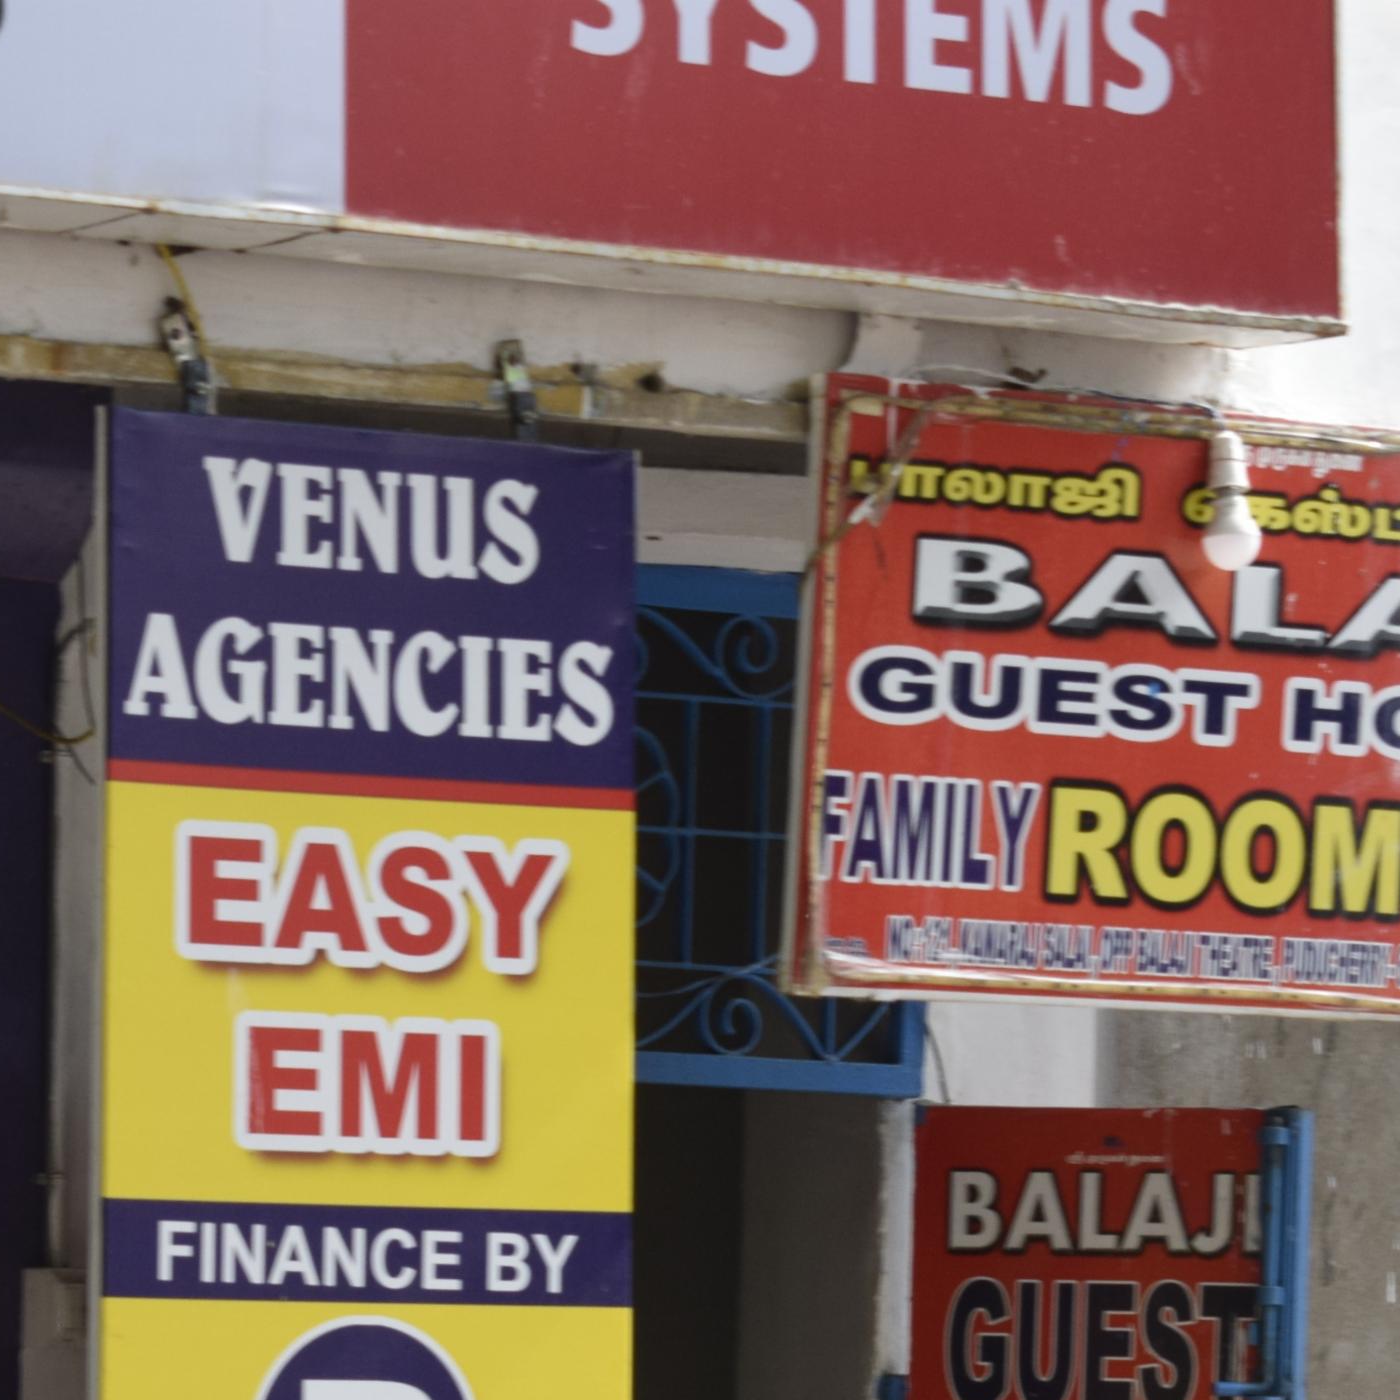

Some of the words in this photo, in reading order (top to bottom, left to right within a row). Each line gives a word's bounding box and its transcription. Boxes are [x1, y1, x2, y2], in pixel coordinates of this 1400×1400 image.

[203, 455, 540, 586] VENUS
[122, 613, 616, 747] AGENCIES
[847, 644, 1261, 747] GUEST
[819, 769, 1039, 890] FAMILY
[174, 819, 570, 977] EASY
[233, 1010, 502, 1159] EMI
[156, 1220, 464, 1291] FINANCE
[485, 1233, 579, 1294] BY
[947, 1168, 1261, 1256] BALAJI
